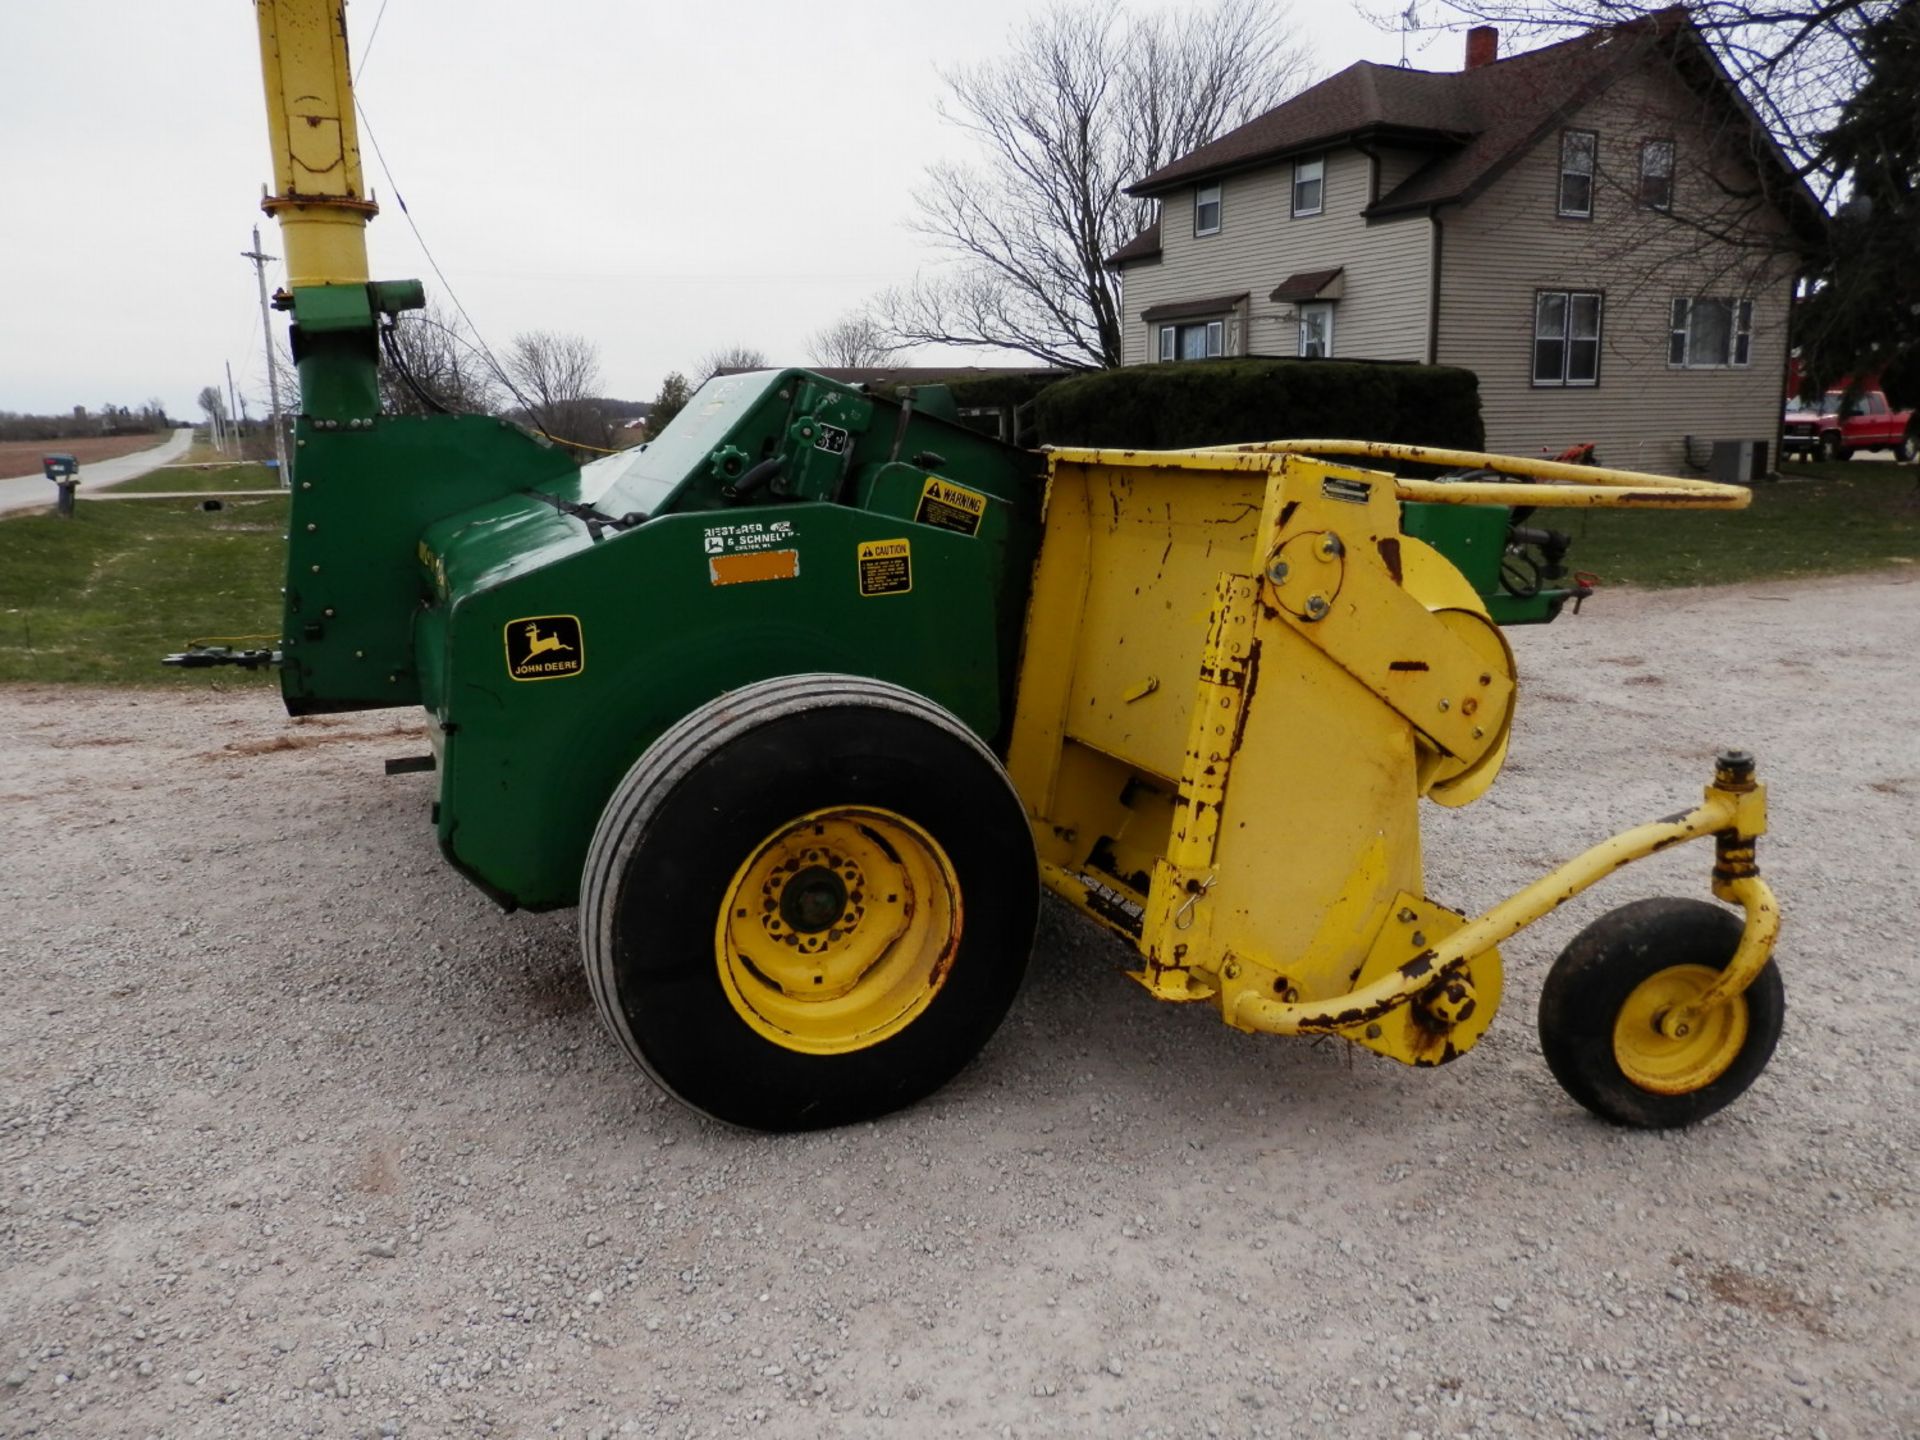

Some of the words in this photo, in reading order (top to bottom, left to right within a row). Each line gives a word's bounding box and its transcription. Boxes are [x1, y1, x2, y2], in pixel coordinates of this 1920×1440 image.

[943, 488, 982, 512] WARNING
[728, 538, 735, 546] &
[875, 544, 906, 556] CAUTION
[515, 664, 542, 675] JOHN
[545, 660, 577, 671] DEERE
